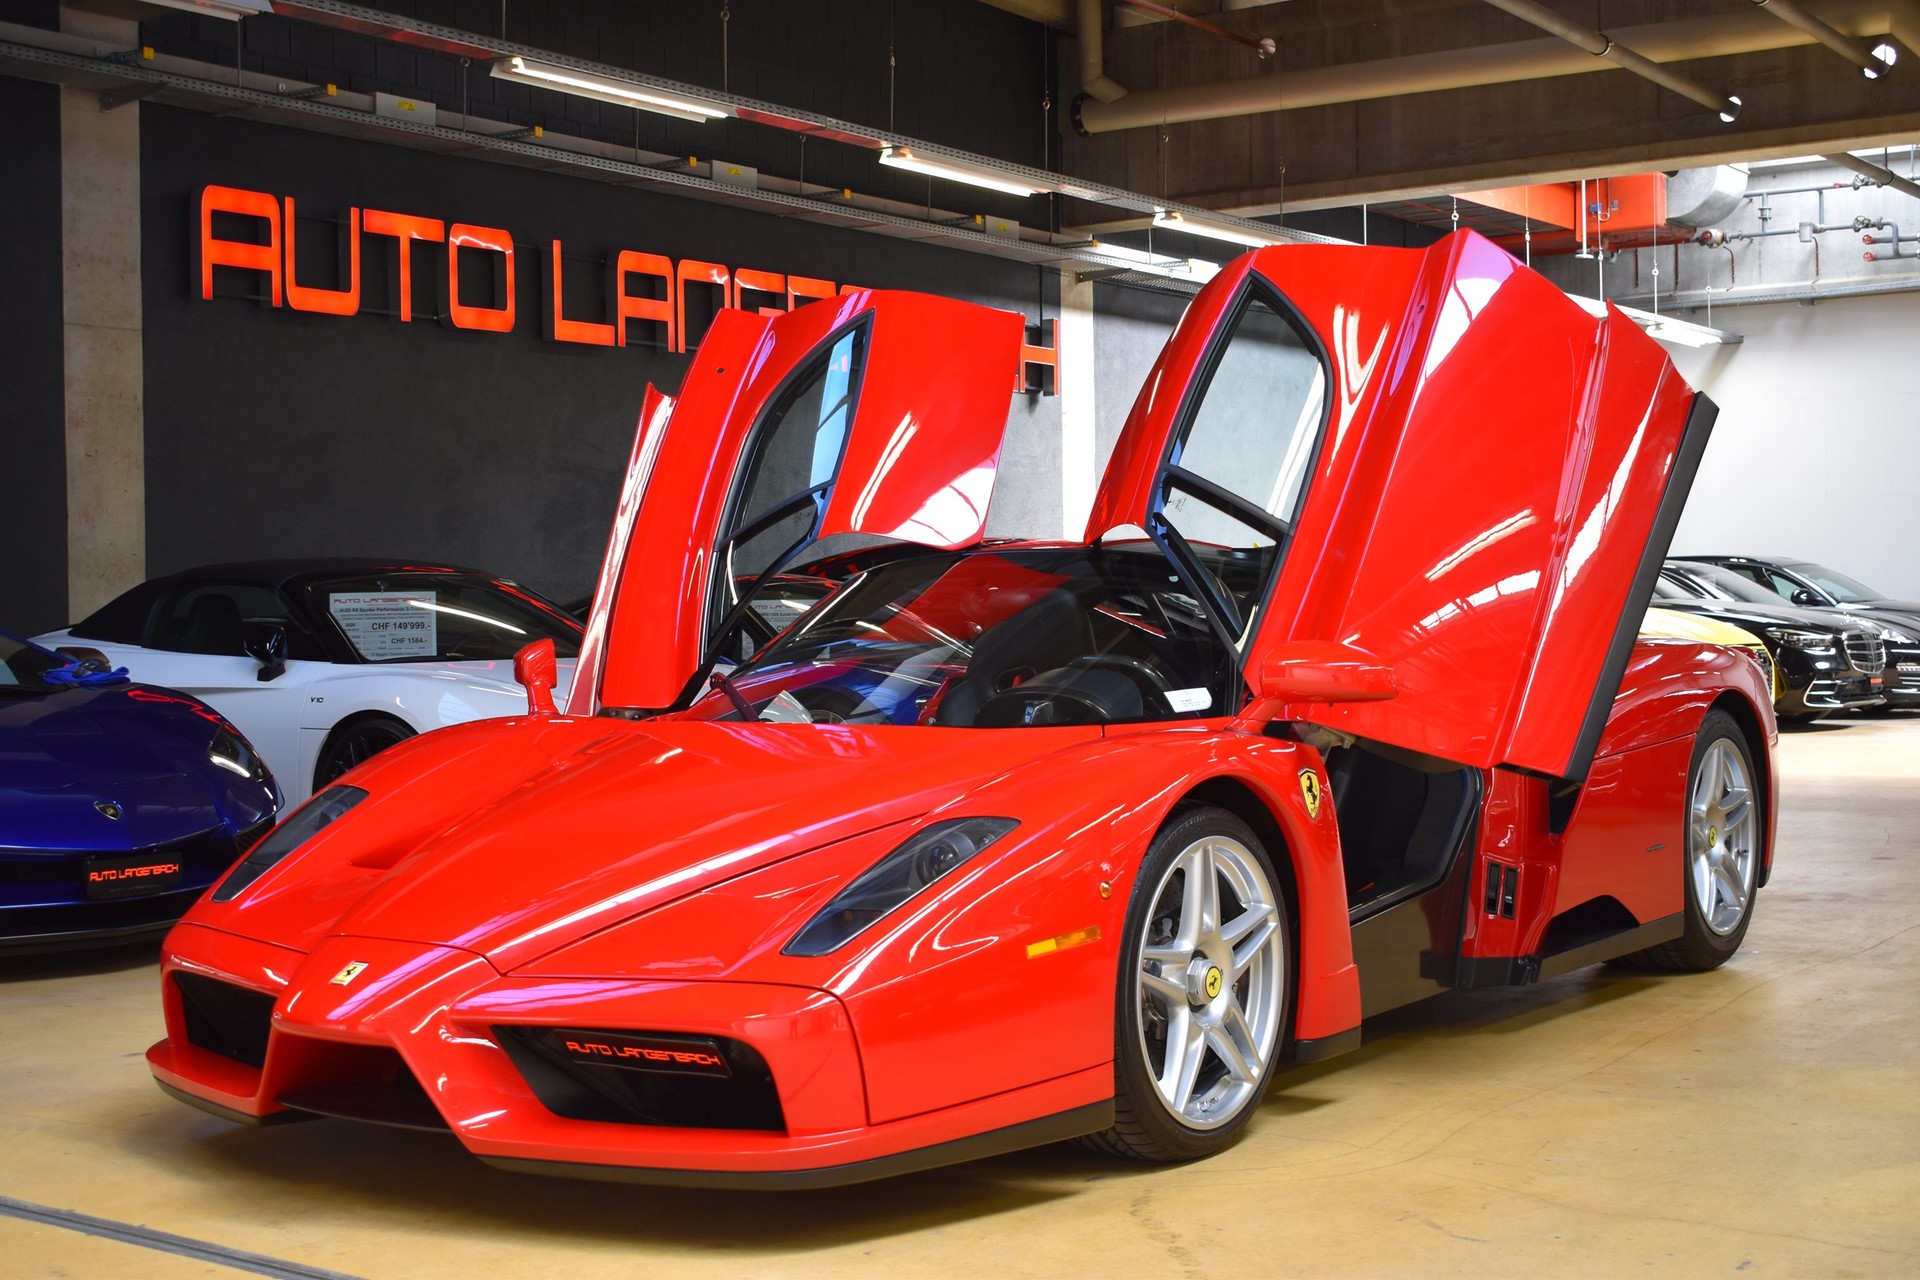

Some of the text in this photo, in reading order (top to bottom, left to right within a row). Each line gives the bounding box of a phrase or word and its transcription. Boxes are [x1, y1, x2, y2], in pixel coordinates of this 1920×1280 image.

[201, 185, 516, 333] AUTO
[371, 621, 431, 631] CHF 149'999.-
[89, 864, 179, 881] AUTO LANGENBACH
[565, 1041, 721, 1065] AUTO LANGENBACH
